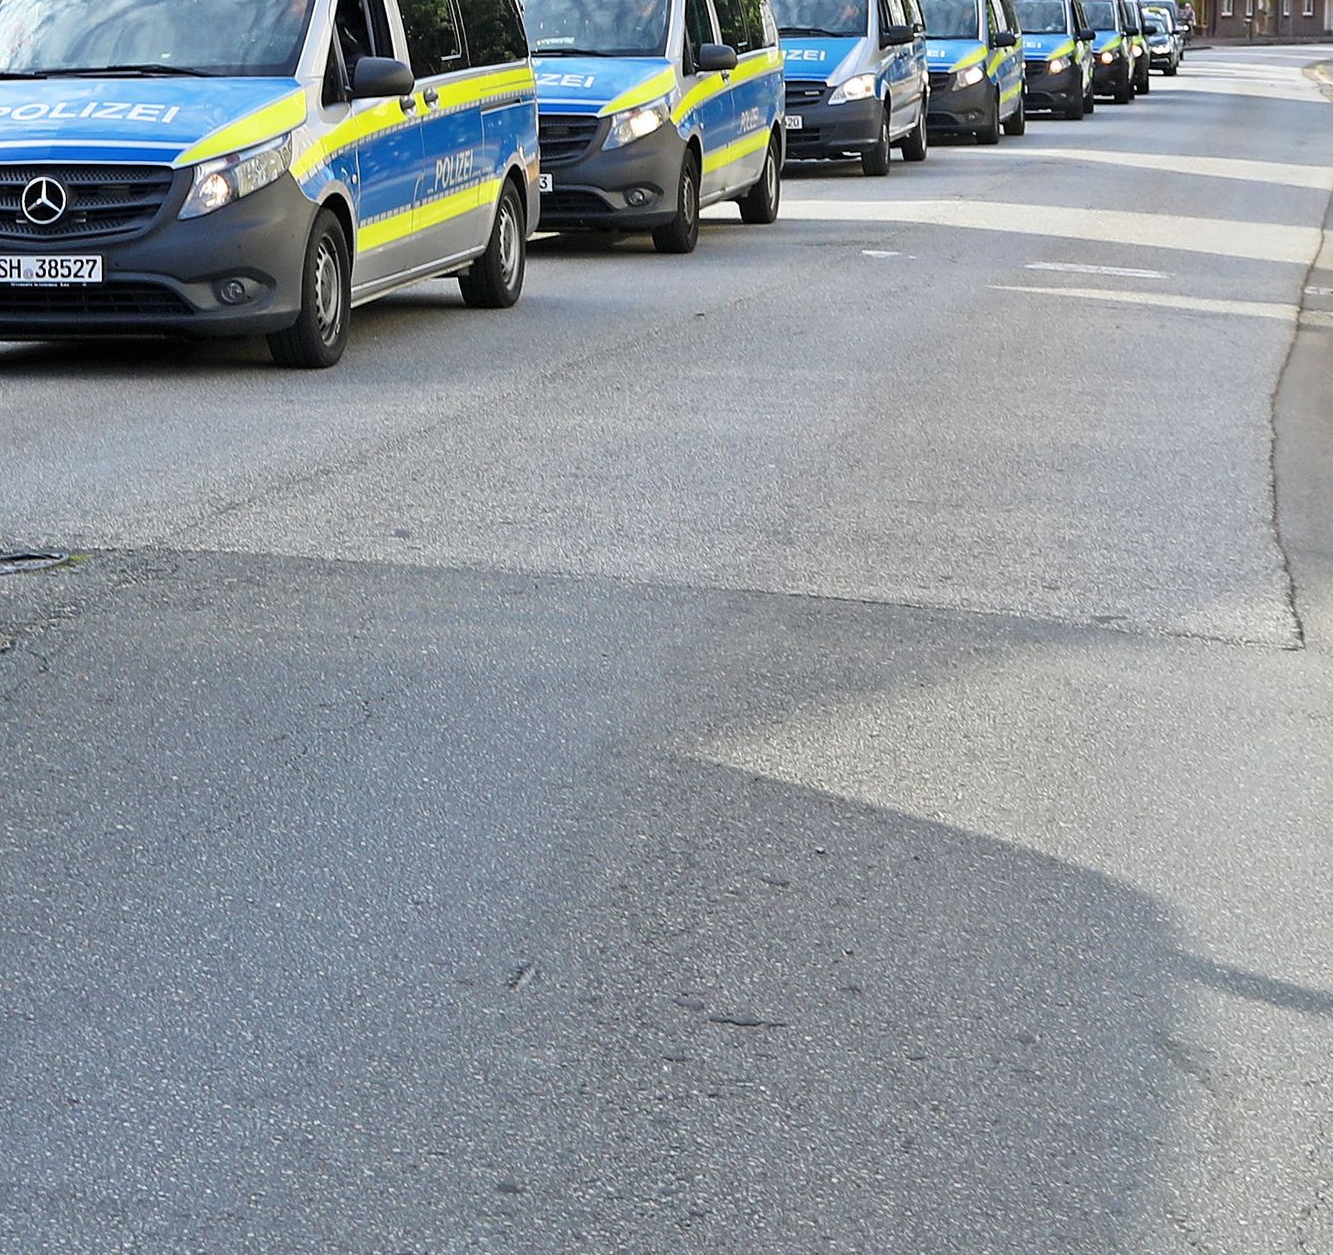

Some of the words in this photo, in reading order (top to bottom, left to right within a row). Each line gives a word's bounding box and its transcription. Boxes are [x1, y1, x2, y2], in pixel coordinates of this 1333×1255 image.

[781, 49, 826, 61] IZEI
[434, 148, 474, 192] POLIZEI
[35, 259, 97, 279] 38527
